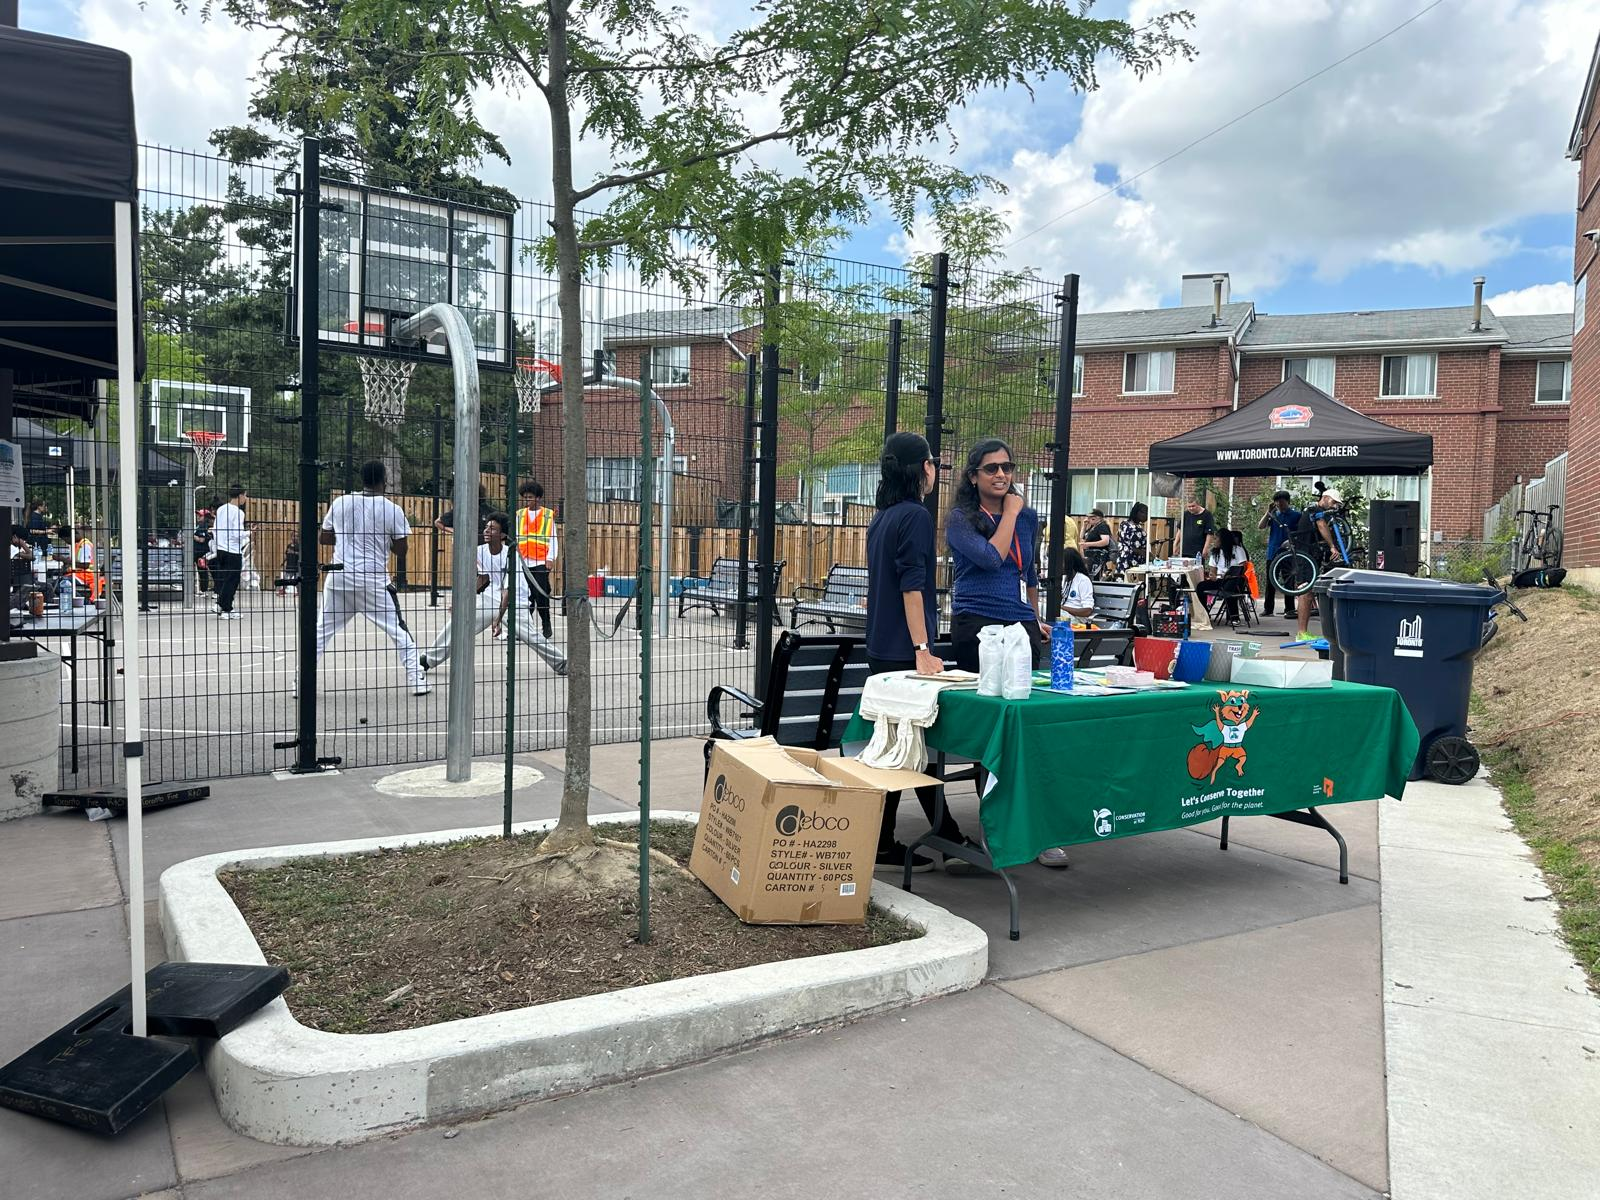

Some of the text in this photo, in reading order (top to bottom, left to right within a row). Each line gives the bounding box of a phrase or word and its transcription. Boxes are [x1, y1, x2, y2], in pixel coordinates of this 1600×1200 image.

[1216, 446, 1358, 461] WWW.TORONTO.CA/FIRE/CAREERS
[1396, 636, 1424, 647] TORONTO
[714, 774, 746, 812] debco
[1181, 796, 1199, 807] Let's
[1226, 787, 1265, 799] Together
[1181, 811, 1196, 819] Good
[1220, 802, 1230, 810] for
[775, 804, 850, 836] debco
[1115, 811, 1146, 821] CONSERVATION
[772, 839, 787, 847] PO
[788, 839, 796, 847] #
[803, 840, 837, 848] HA2298
[770, 850, 808, 859] STYLE#
[815, 851, 851, 860] WB7107
[768, 861, 811, 870] COLOUR
[819, 862, 853, 870] SILVER
[767, 872, 817, 881] QUANTITY
[765, 883, 806, 892] CARTON
[808, 884, 815, 892] #
